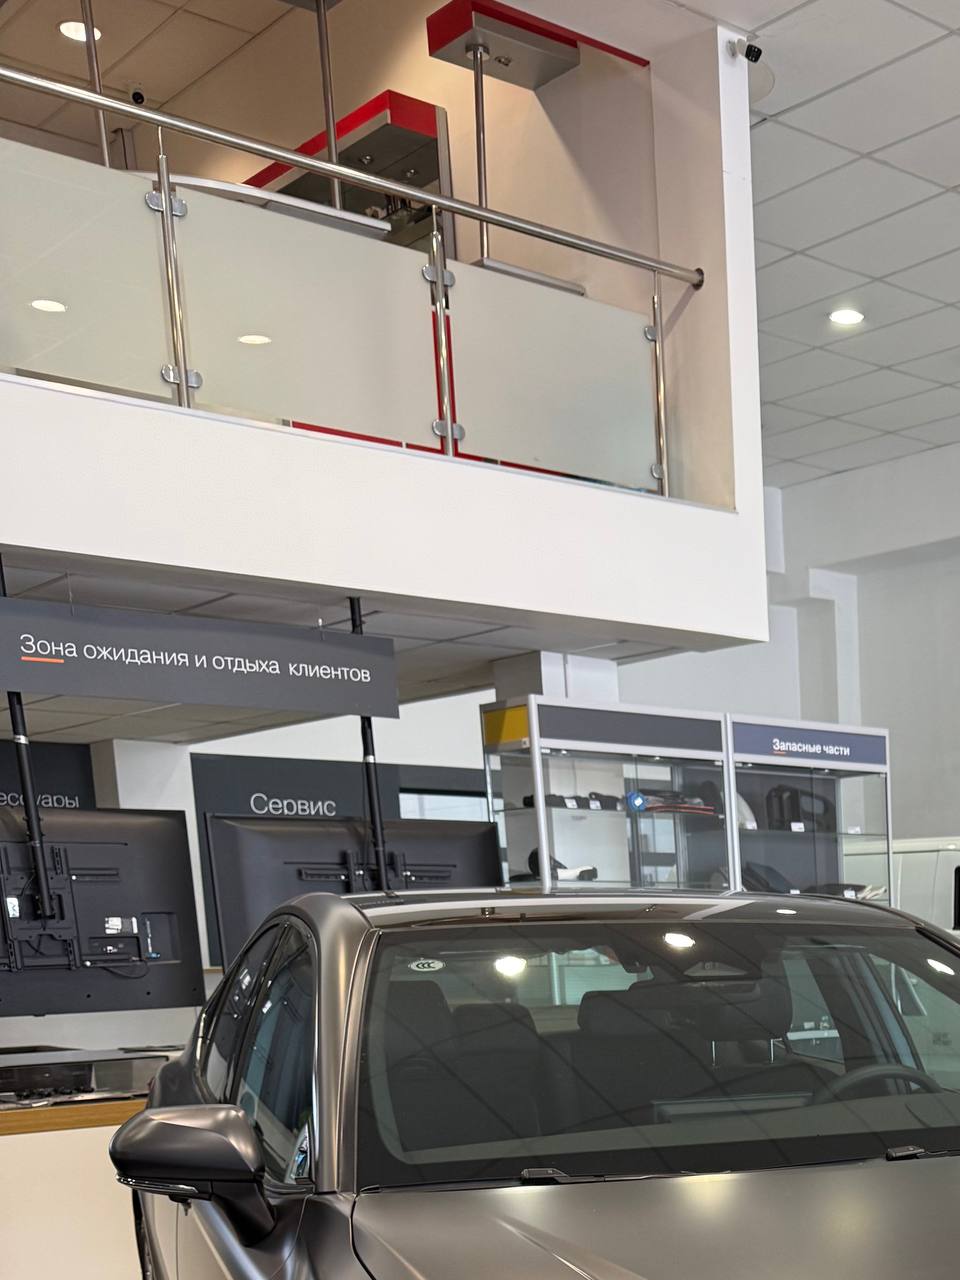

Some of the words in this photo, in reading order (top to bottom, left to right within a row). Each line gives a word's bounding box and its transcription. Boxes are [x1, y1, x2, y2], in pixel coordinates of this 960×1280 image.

[20, 633, 78, 658] Зона
[83, 642, 189, 667] ожидания
[195, 655, 207, 668] и
[212, 656, 280, 674] отдыха
[288, 661, 371, 682] клиентов
[772, 738, 821, 753] Запасные
[823, 745, 850, 756] части
[250, 792, 336, 816] Сервис
